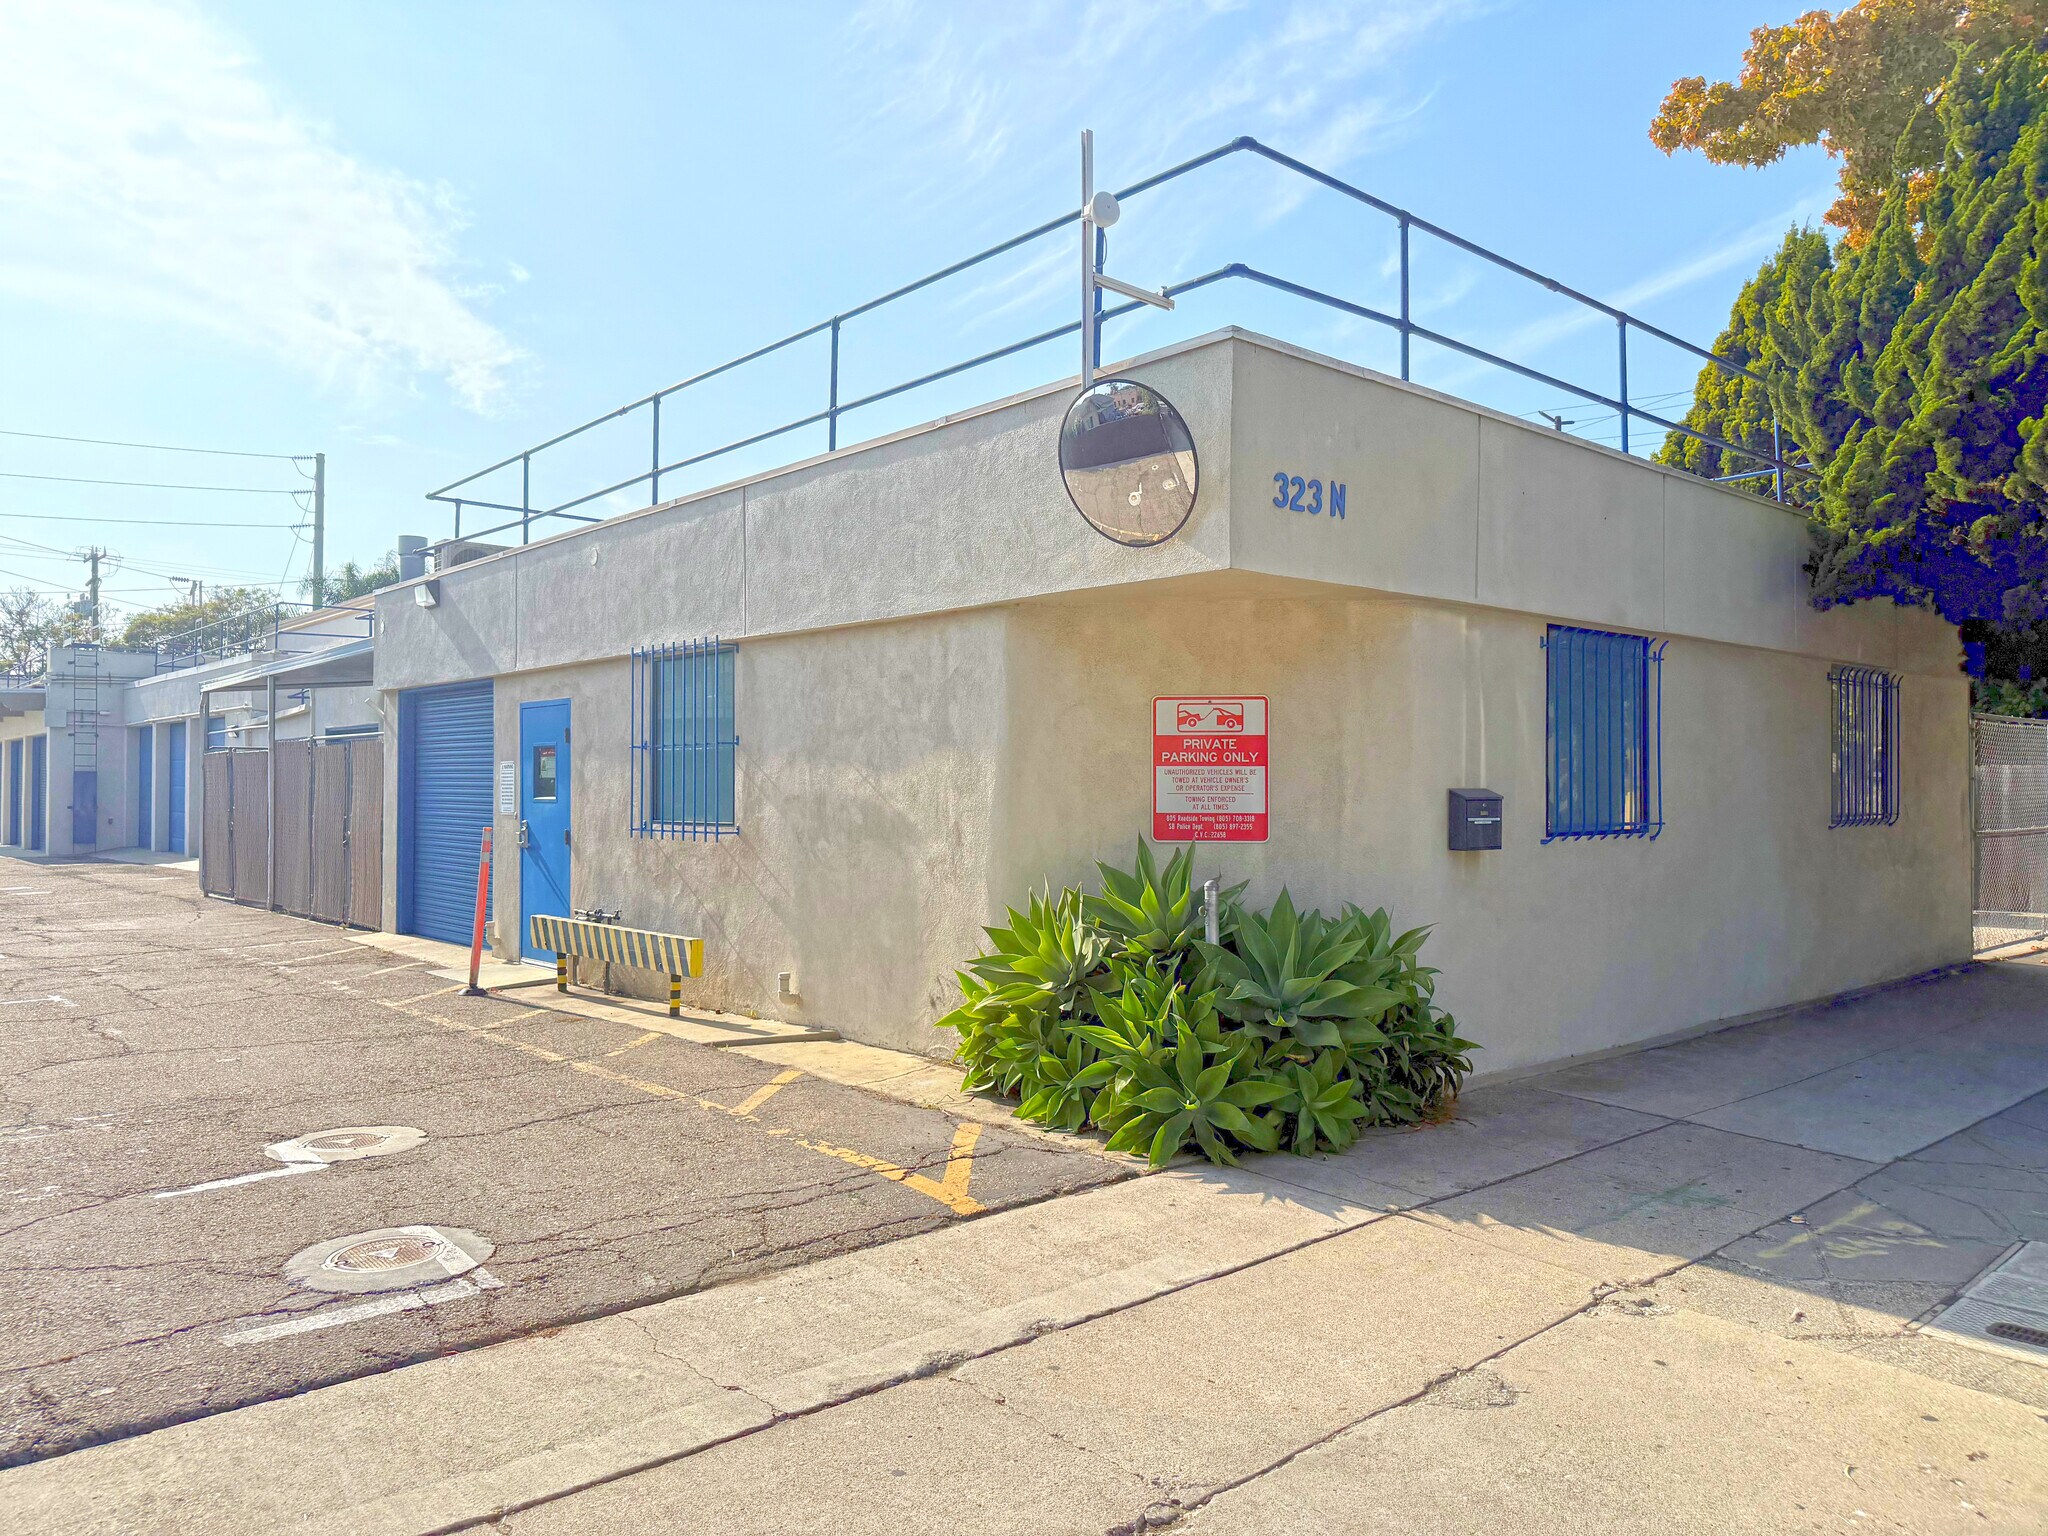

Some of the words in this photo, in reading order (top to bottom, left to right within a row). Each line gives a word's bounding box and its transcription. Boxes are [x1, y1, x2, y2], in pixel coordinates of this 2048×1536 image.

[1272, 472, 1323, 515] 323
[1330, 480, 1347, 520] N
[1183, 739, 1237, 749] PRIVATE
[1161, 752, 1218, 763] PARKING
[1223, 752, 1259, 763] ONLY
[1199, 815, 1215, 823] Towing
